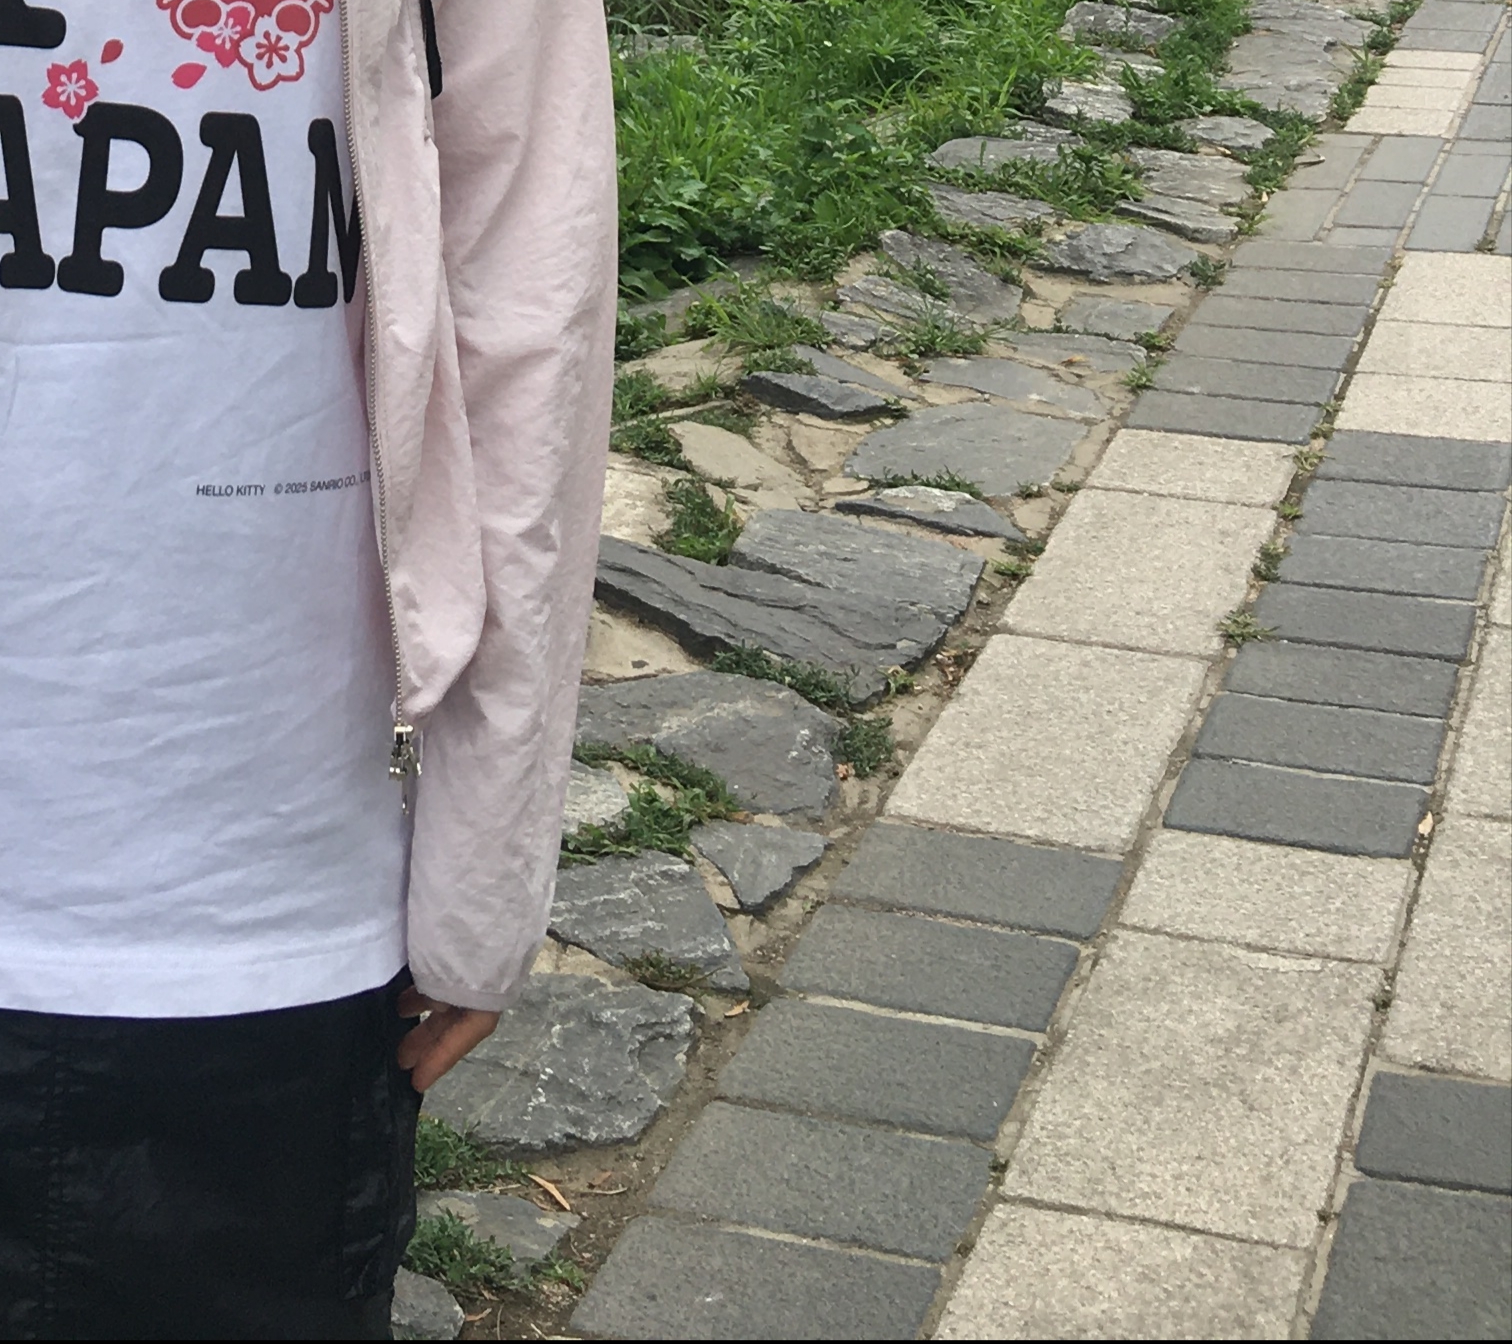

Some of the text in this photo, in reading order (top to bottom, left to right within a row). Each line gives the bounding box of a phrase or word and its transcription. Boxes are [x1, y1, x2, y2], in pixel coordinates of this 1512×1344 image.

[195, 484, 234, 497] HELLO
[236, 484, 266, 497] KITTY
[285, 480, 308, 494] 2025
[310, 477, 344, 493] SANRIO
